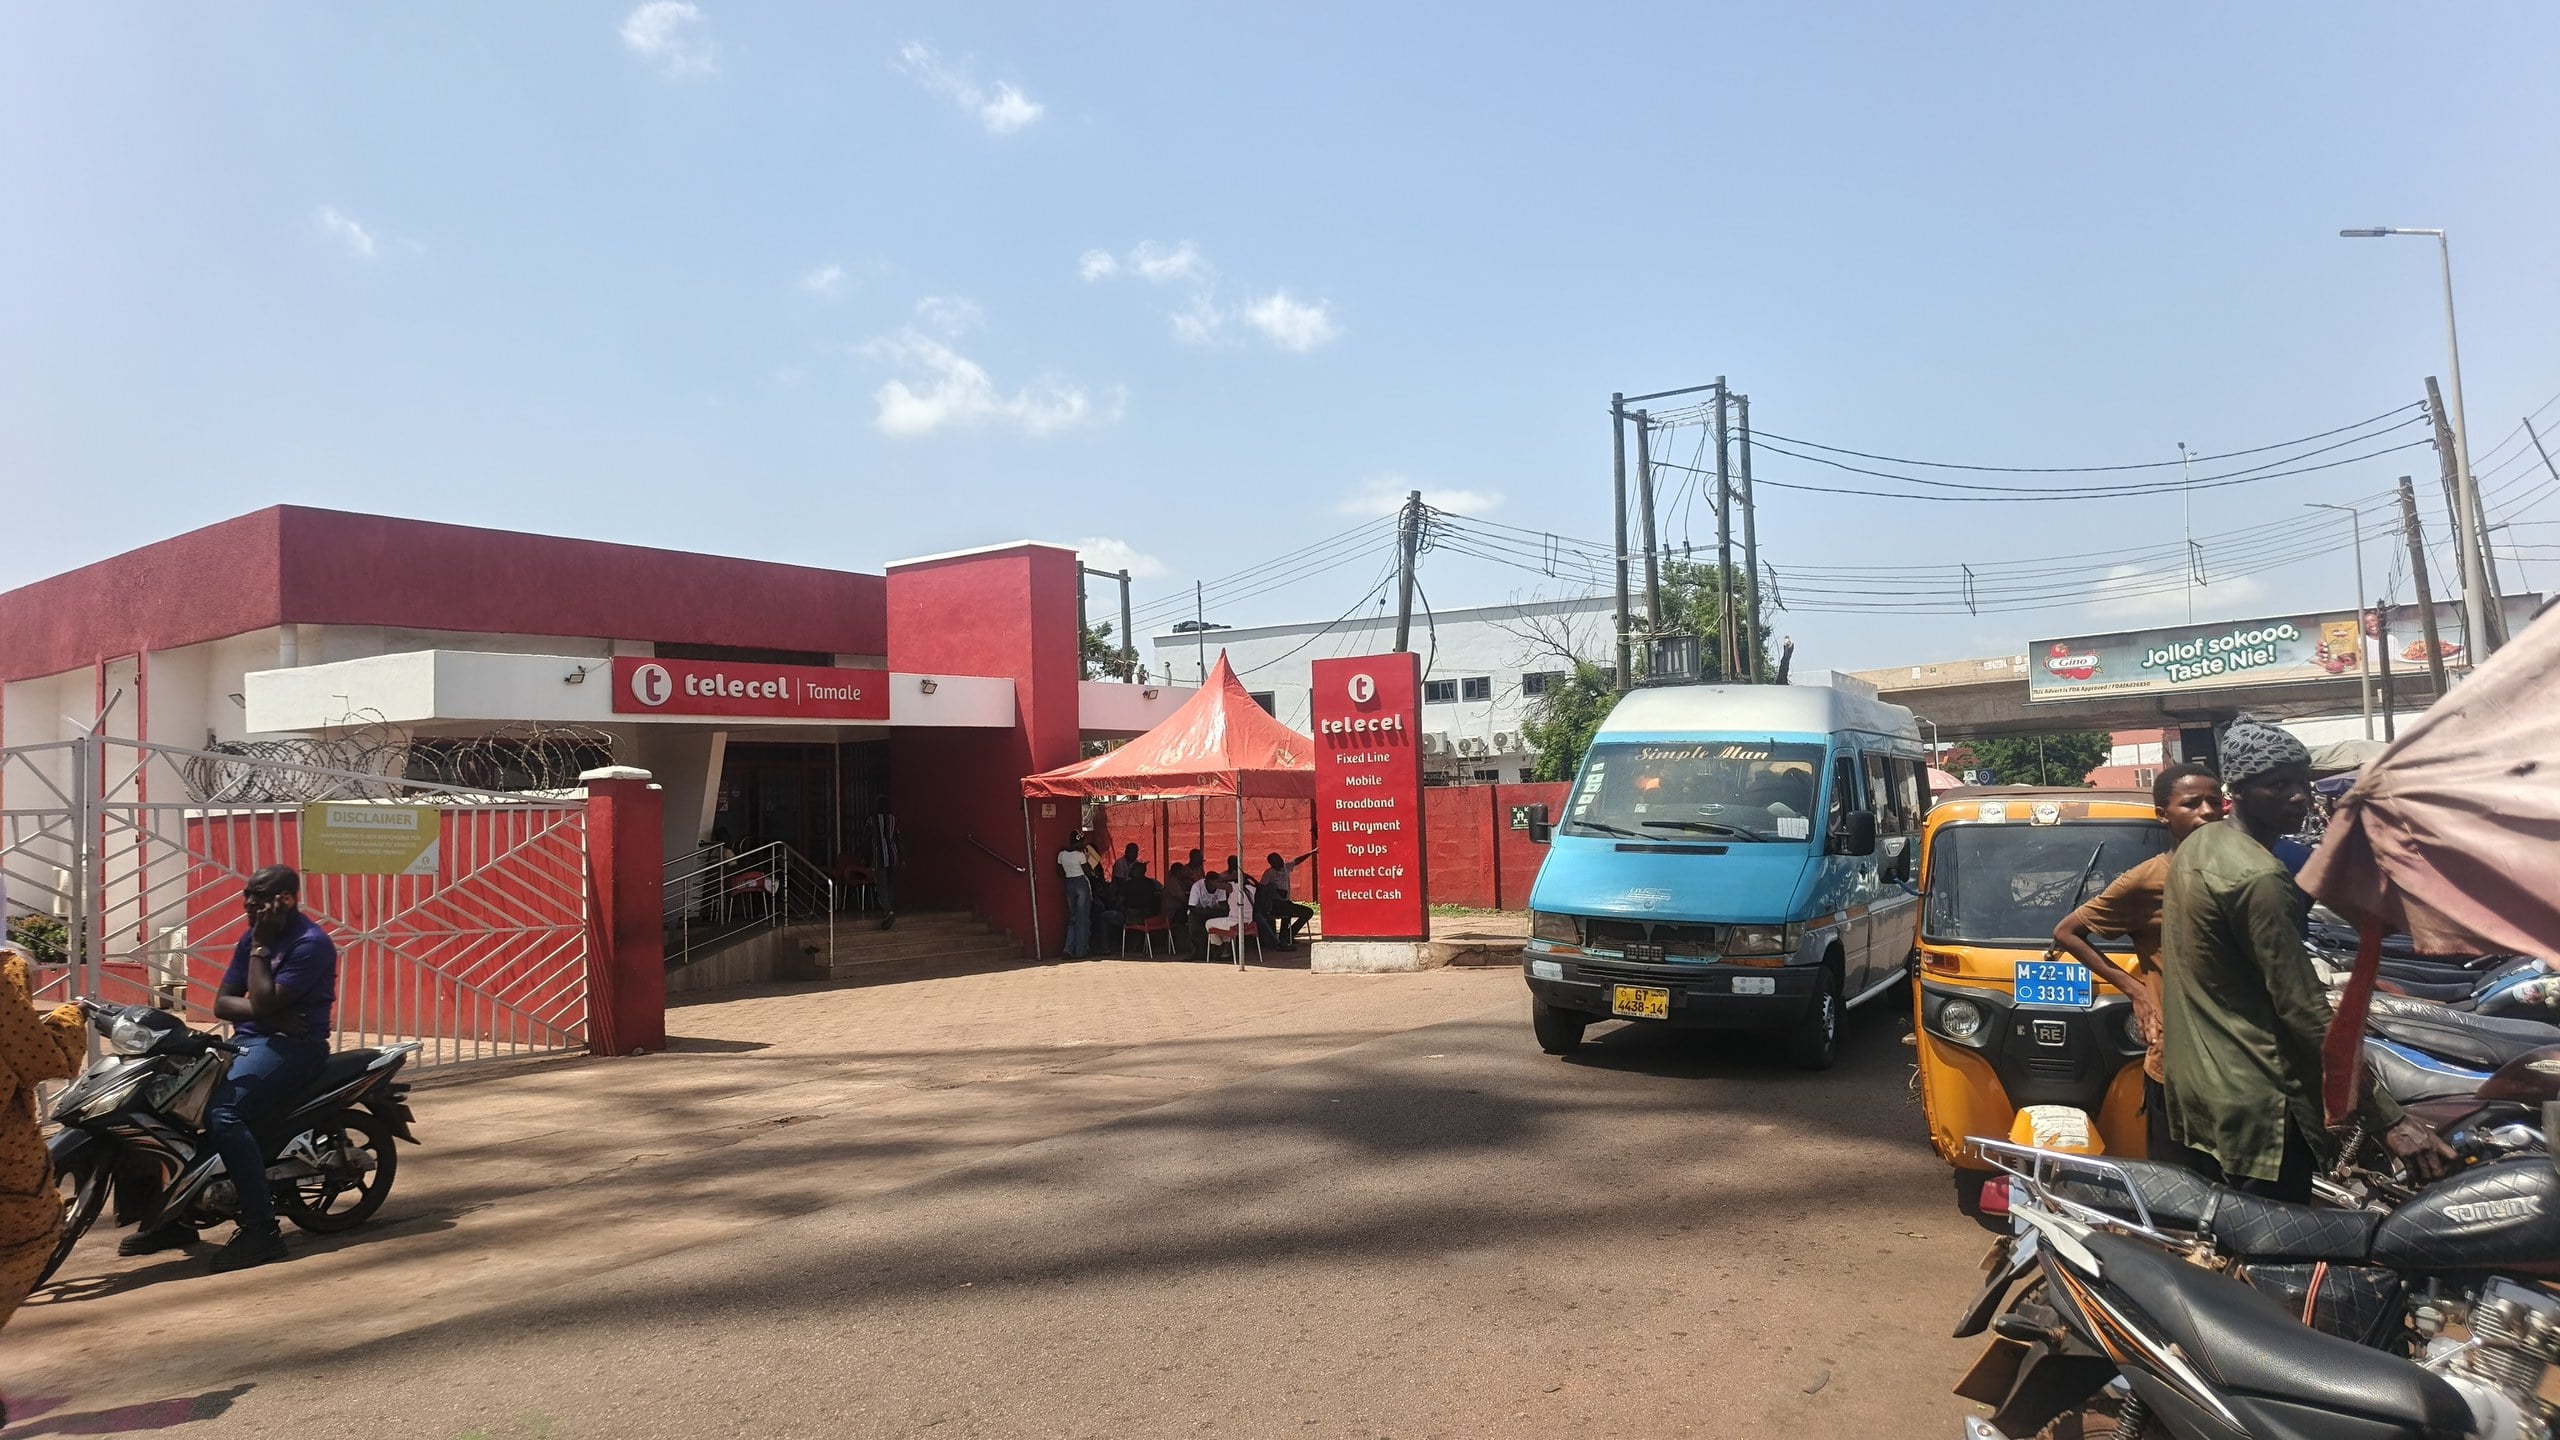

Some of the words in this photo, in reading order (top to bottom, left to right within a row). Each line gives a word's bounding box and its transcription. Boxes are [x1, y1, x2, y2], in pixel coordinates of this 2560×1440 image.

[2142, 637, 2204, 668] Jollof
[2208, 624, 2300, 654] sokooo,
[2058, 658, 2088, 667] Gino
[2166, 657, 2225, 682] Taste
[2229, 644, 2276, 670] Nie!
[685, 673, 790, 700] telecel
[806, 683, 862, 701] Tamale
[2081, 684, 2108, 693] Approved
[1321, 713, 1403, 735] telecel
[1336, 752, 1364, 764] Fixed
[1367, 752, 1390, 762] Line
[1634, 745, 1709, 761] Simple
[1713, 745, 1769, 760] Man
[1345, 775, 1382, 786] Mobile
[1336, 797, 1394, 809] Broadband
[333, 811, 412, 826] DISCLAIMER
[1332, 821, 1350, 832] Bill
[1353, 820, 1400, 834] Payment
[1346, 844, 1364, 856] Top
[1367, 844, 1387, 856] Ups
[1333, 866, 1375, 877] Internet
[1336, 889, 1373, 900] Telecel
[1375, 889, 1401, 900] Cash
[1635, 989, 1648, 1001] GT
[2037, 985, 2074, 1002] 3331
[1618, 999, 1664, 1015] 4438-14
[2040, 1028, 2061, 1041] RE
